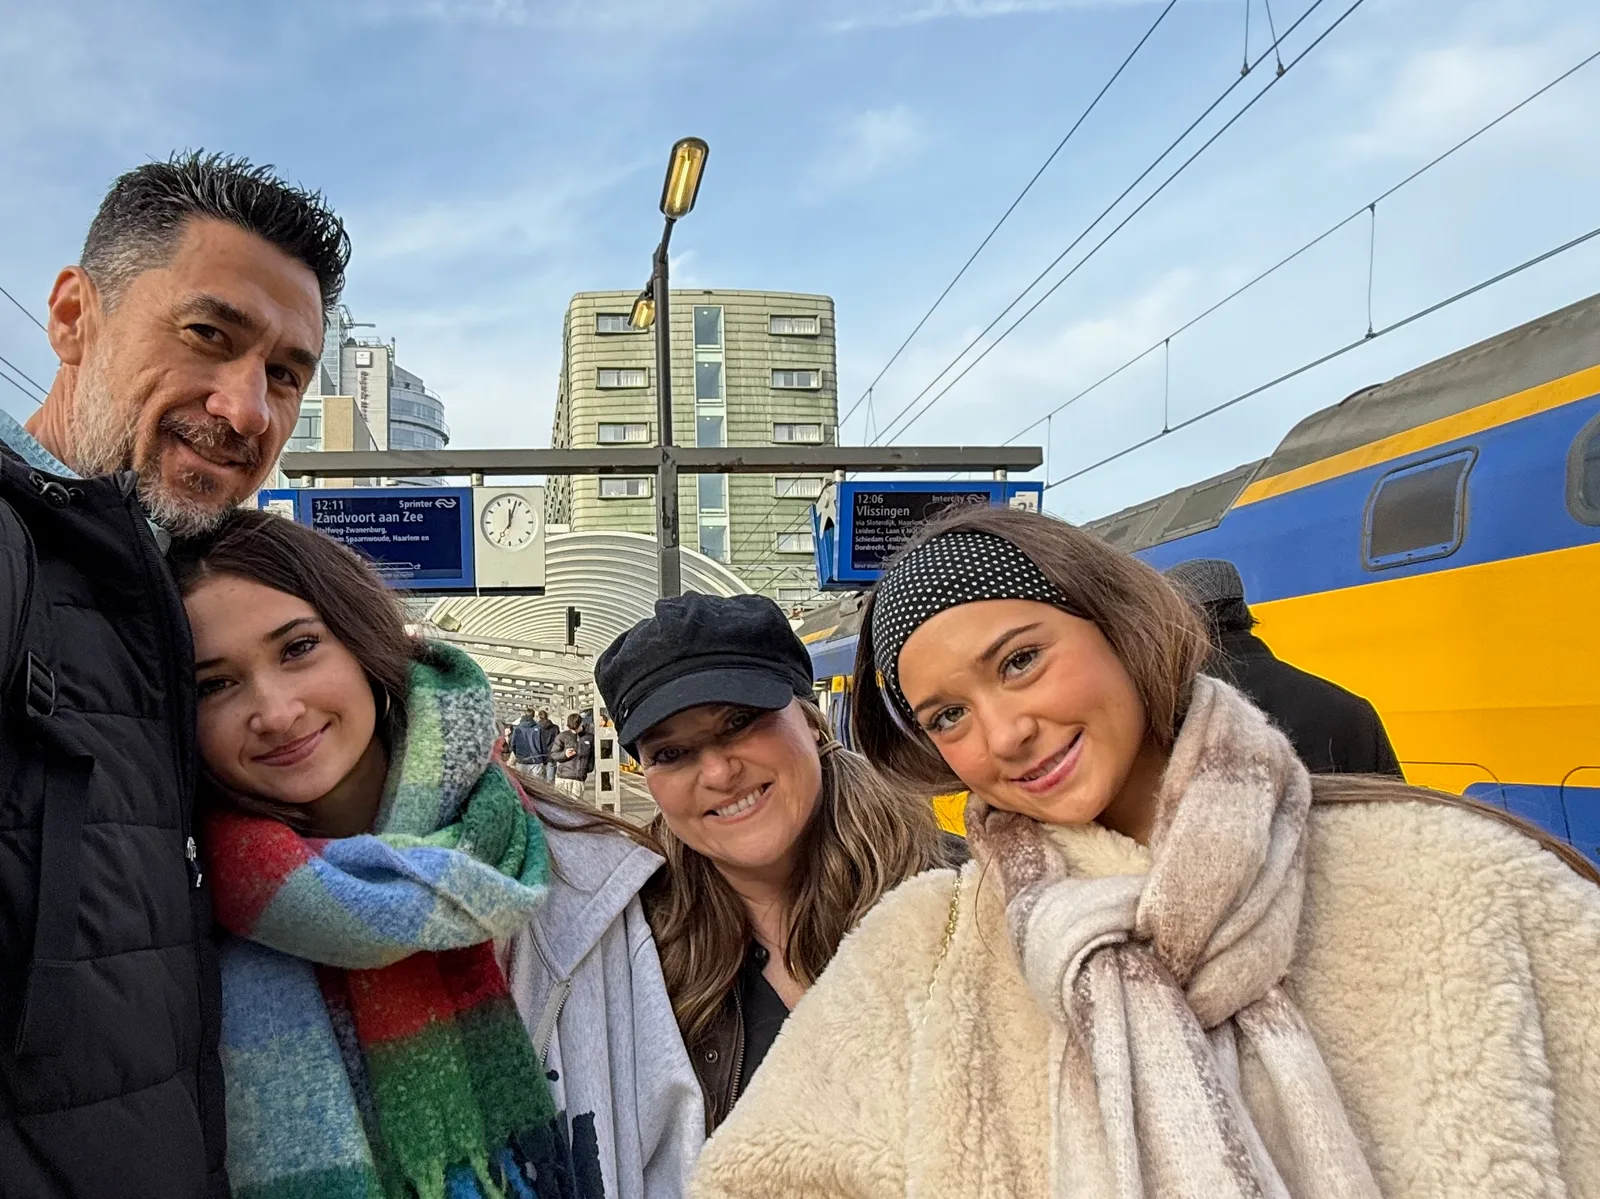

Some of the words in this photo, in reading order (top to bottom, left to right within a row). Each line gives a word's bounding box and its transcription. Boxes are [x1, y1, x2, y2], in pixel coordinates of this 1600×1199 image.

[857, 494, 884, 504] 12:06
[315, 500, 344, 510] 12:11
[398, 500, 433, 510] Sprinter
[315, 511, 376, 523] Zandvoort
[378, 513, 399, 523] aan
[402, 511, 424, 522] Zee
[856, 505, 910, 519] Vlissingen
[345, 535, 392, 544] Spaarnwoude,
[392, 534, 420, 542] Haarlem
[855, 535, 884, 543] Schiedam
[855, 543, 886, 551] Dordrecht,
